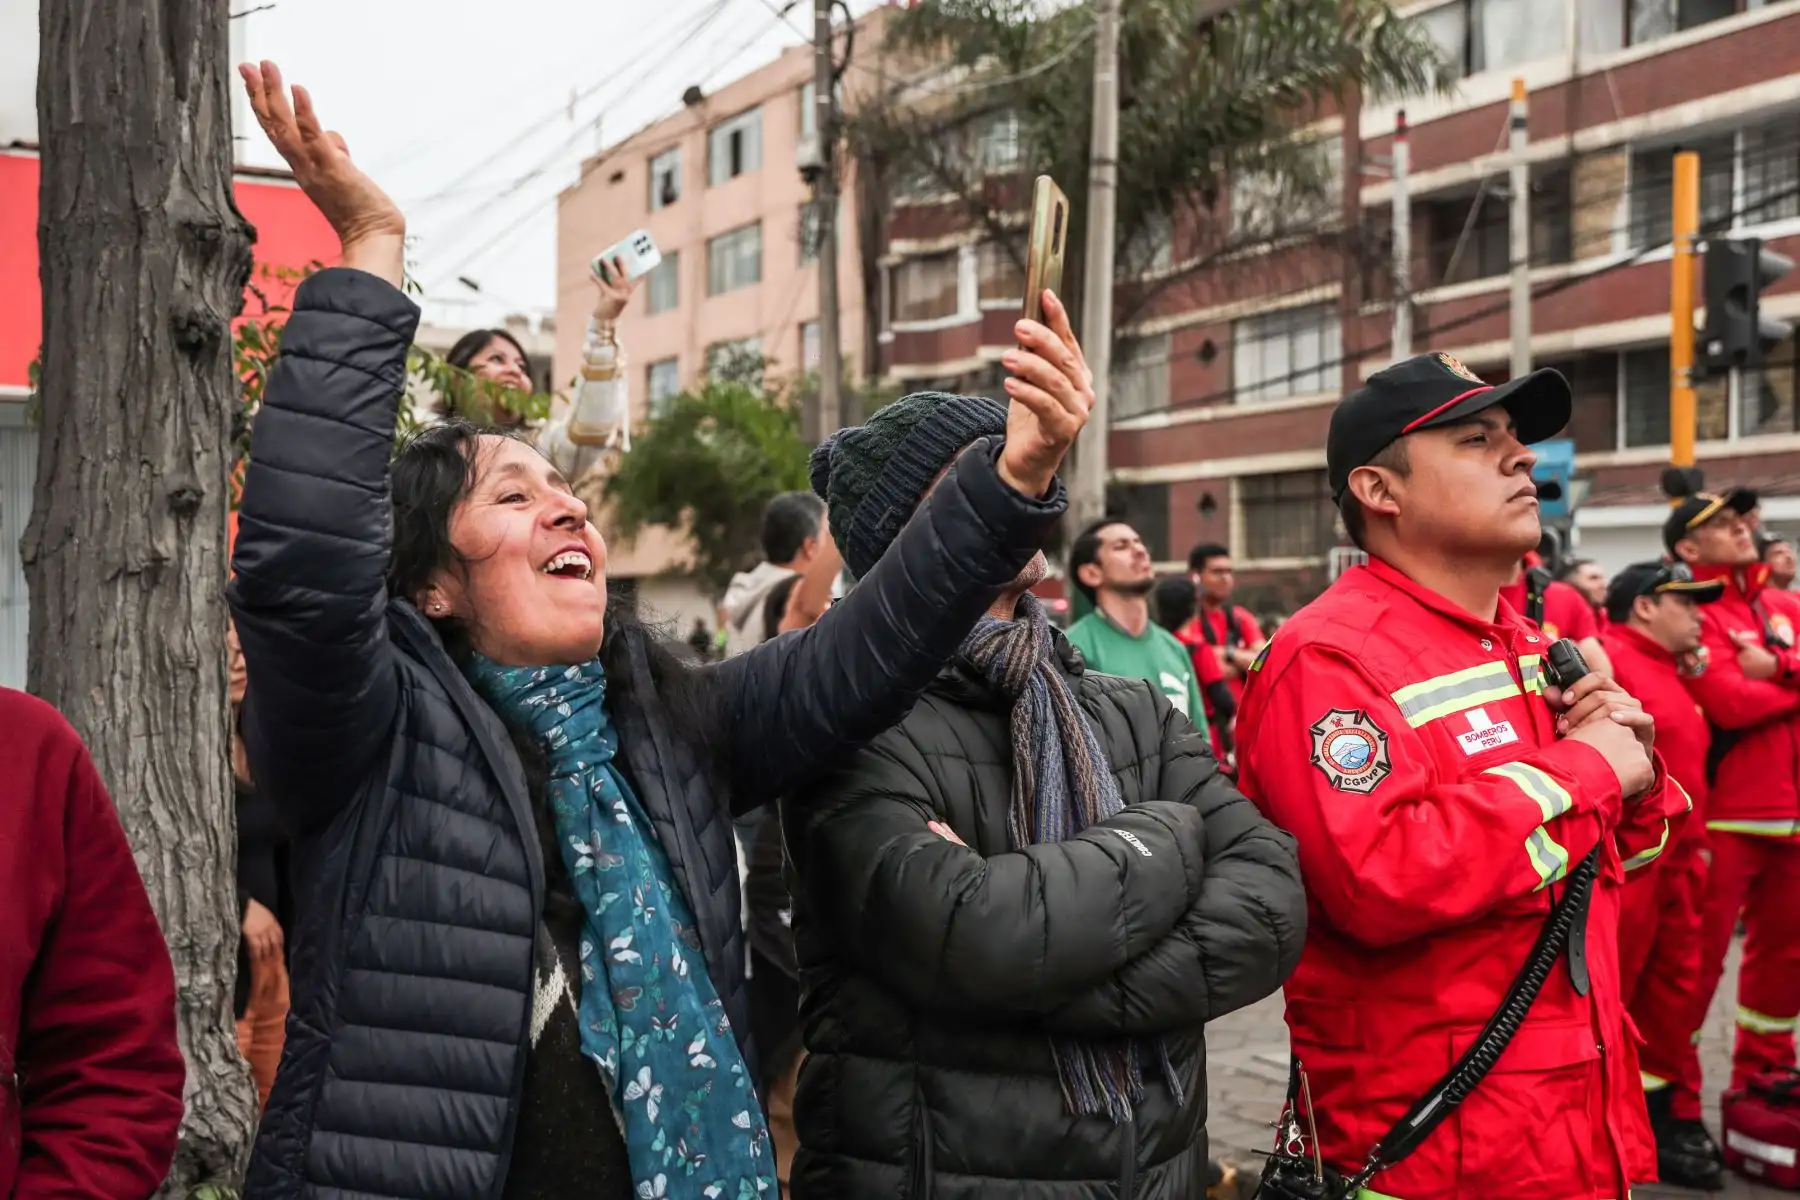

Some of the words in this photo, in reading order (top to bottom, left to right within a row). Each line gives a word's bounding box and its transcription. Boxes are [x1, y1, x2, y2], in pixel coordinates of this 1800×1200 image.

[1465, 725, 1508, 743] BOMBEROS
[1481, 736, 1502, 748] PERU
[1344, 768, 1379, 786] CGBVP
